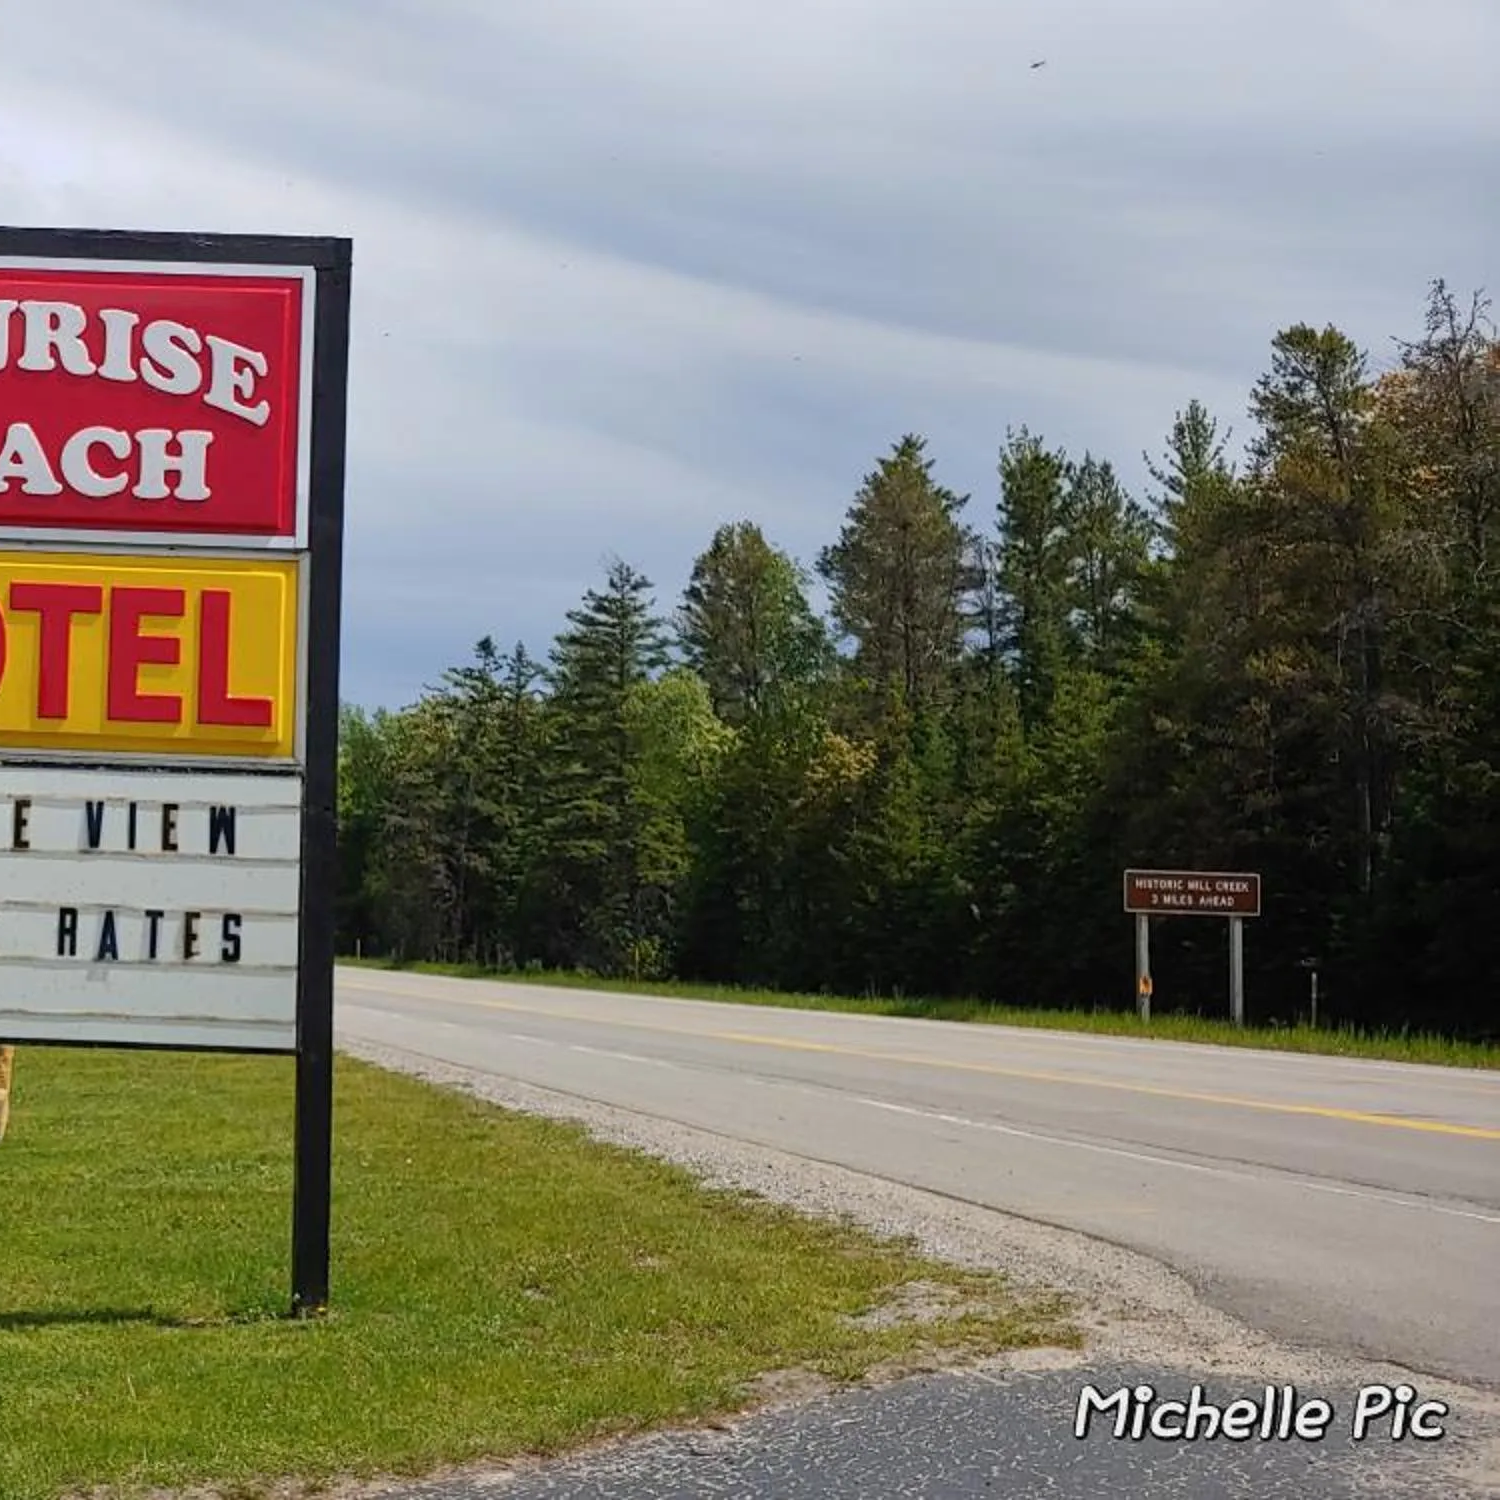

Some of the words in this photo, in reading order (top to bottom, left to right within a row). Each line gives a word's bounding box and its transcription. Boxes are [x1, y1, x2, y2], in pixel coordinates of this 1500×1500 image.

[85, 802, 237, 856] VIEW
[1135, 879, 1183, 890] HISTORIC
[1187, 880, 1212, 891] MILL
[1215, 881, 1249, 892] CREEK
[1163, 895, 1193, 905] MILES
[1199, 896, 1235, 907] AHEAD
[56, 906, 242, 962] RATES
